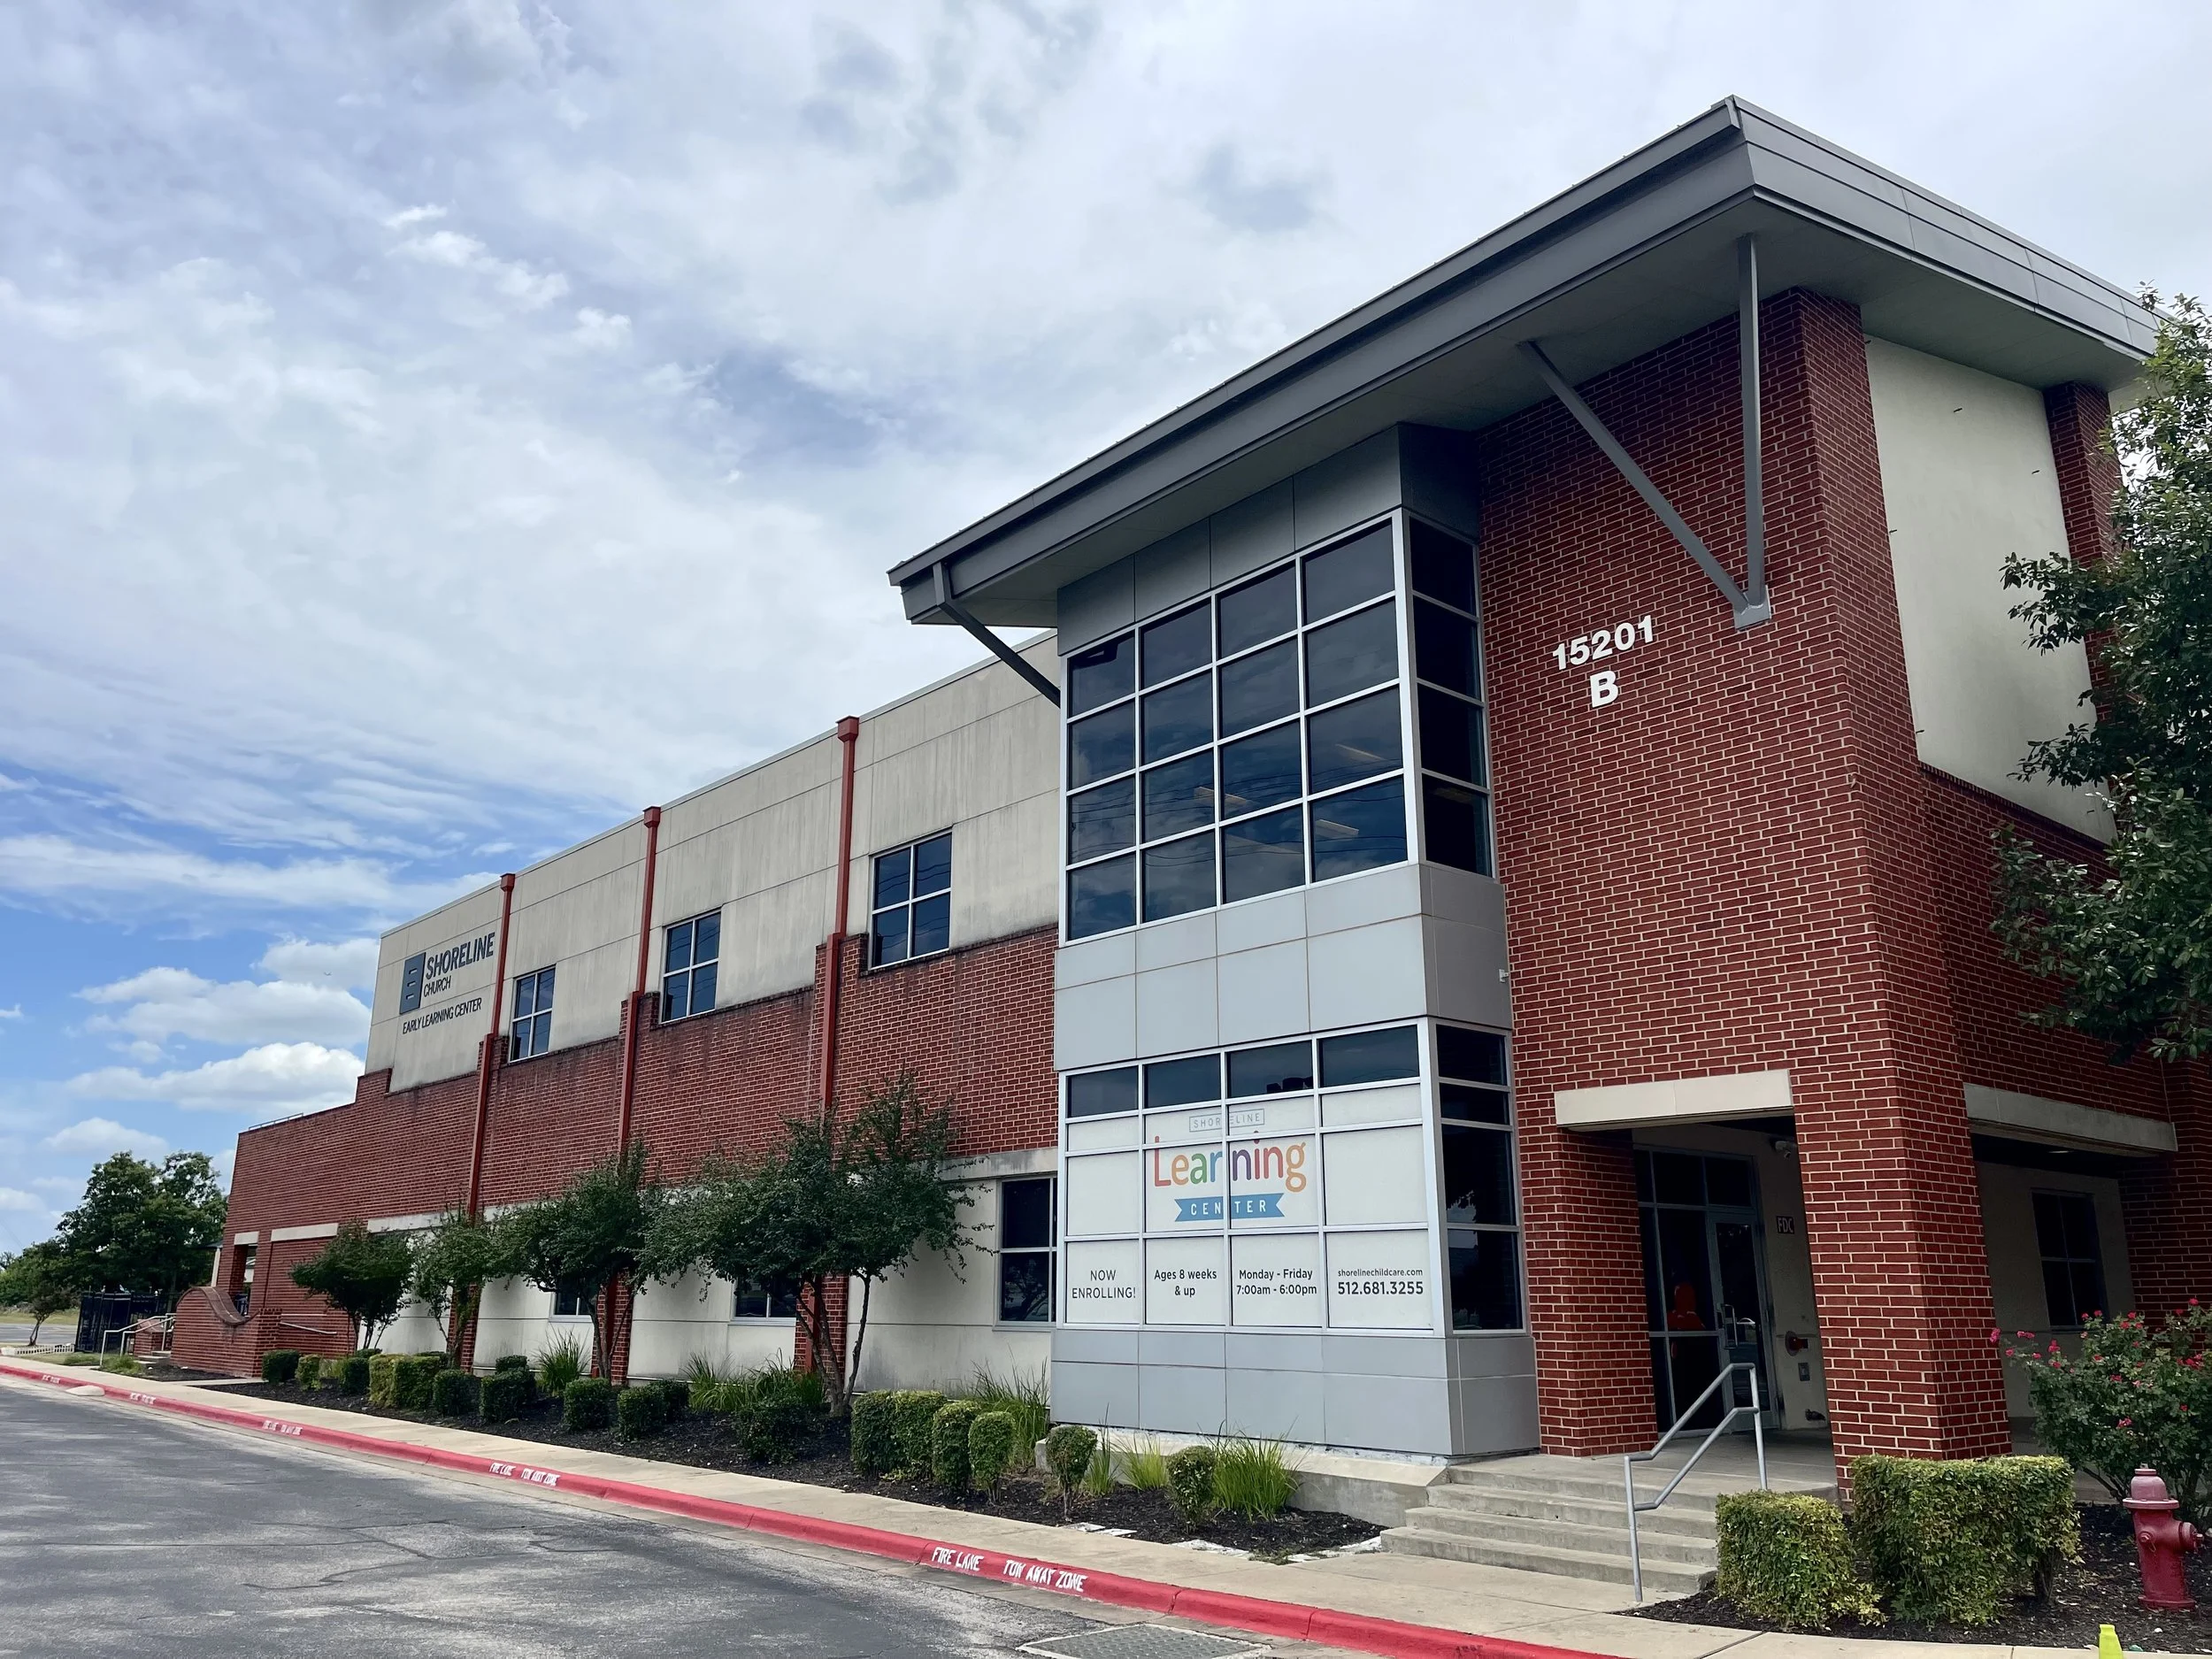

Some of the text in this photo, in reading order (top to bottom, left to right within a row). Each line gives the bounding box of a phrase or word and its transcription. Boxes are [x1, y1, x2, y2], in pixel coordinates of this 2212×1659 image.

[1552, 614, 1654, 671] 15201
[1590, 670, 1619, 708] B
[426, 932, 495, 979] SHORELINE
[423, 975, 452, 998] CHURCH
[402, 997, 482, 1034] EARLY LEARNING CENTER
[1154, 1131, 1307, 1193] Learning
[1190, 1200, 1266, 1216] CENTER
[1778, 1217, 1793, 1233] FDC
[1090, 1269, 1117, 1281] NOW
[1154, 1269, 1217, 1282] Ages 8 weeks
[1239, 1270, 1274, 1281] Monday
[1283, 1269, 1313, 1280] Friday
[1338, 1268, 1423, 1277] shorelinechildcare.com
[1071, 1286, 1136, 1299] ENROLLING!
[1174, 1286, 1195, 1298] & up
[1236, 1285, 1271, 1295] 7:00am
[1279, 1284, 1317, 1296] 6:00pm
[1338, 1281, 1424, 1294] 512.681.3255
[932, 1547, 985, 1571] FIRE LANE
[1055, 1571, 1088, 1593] ZONE
